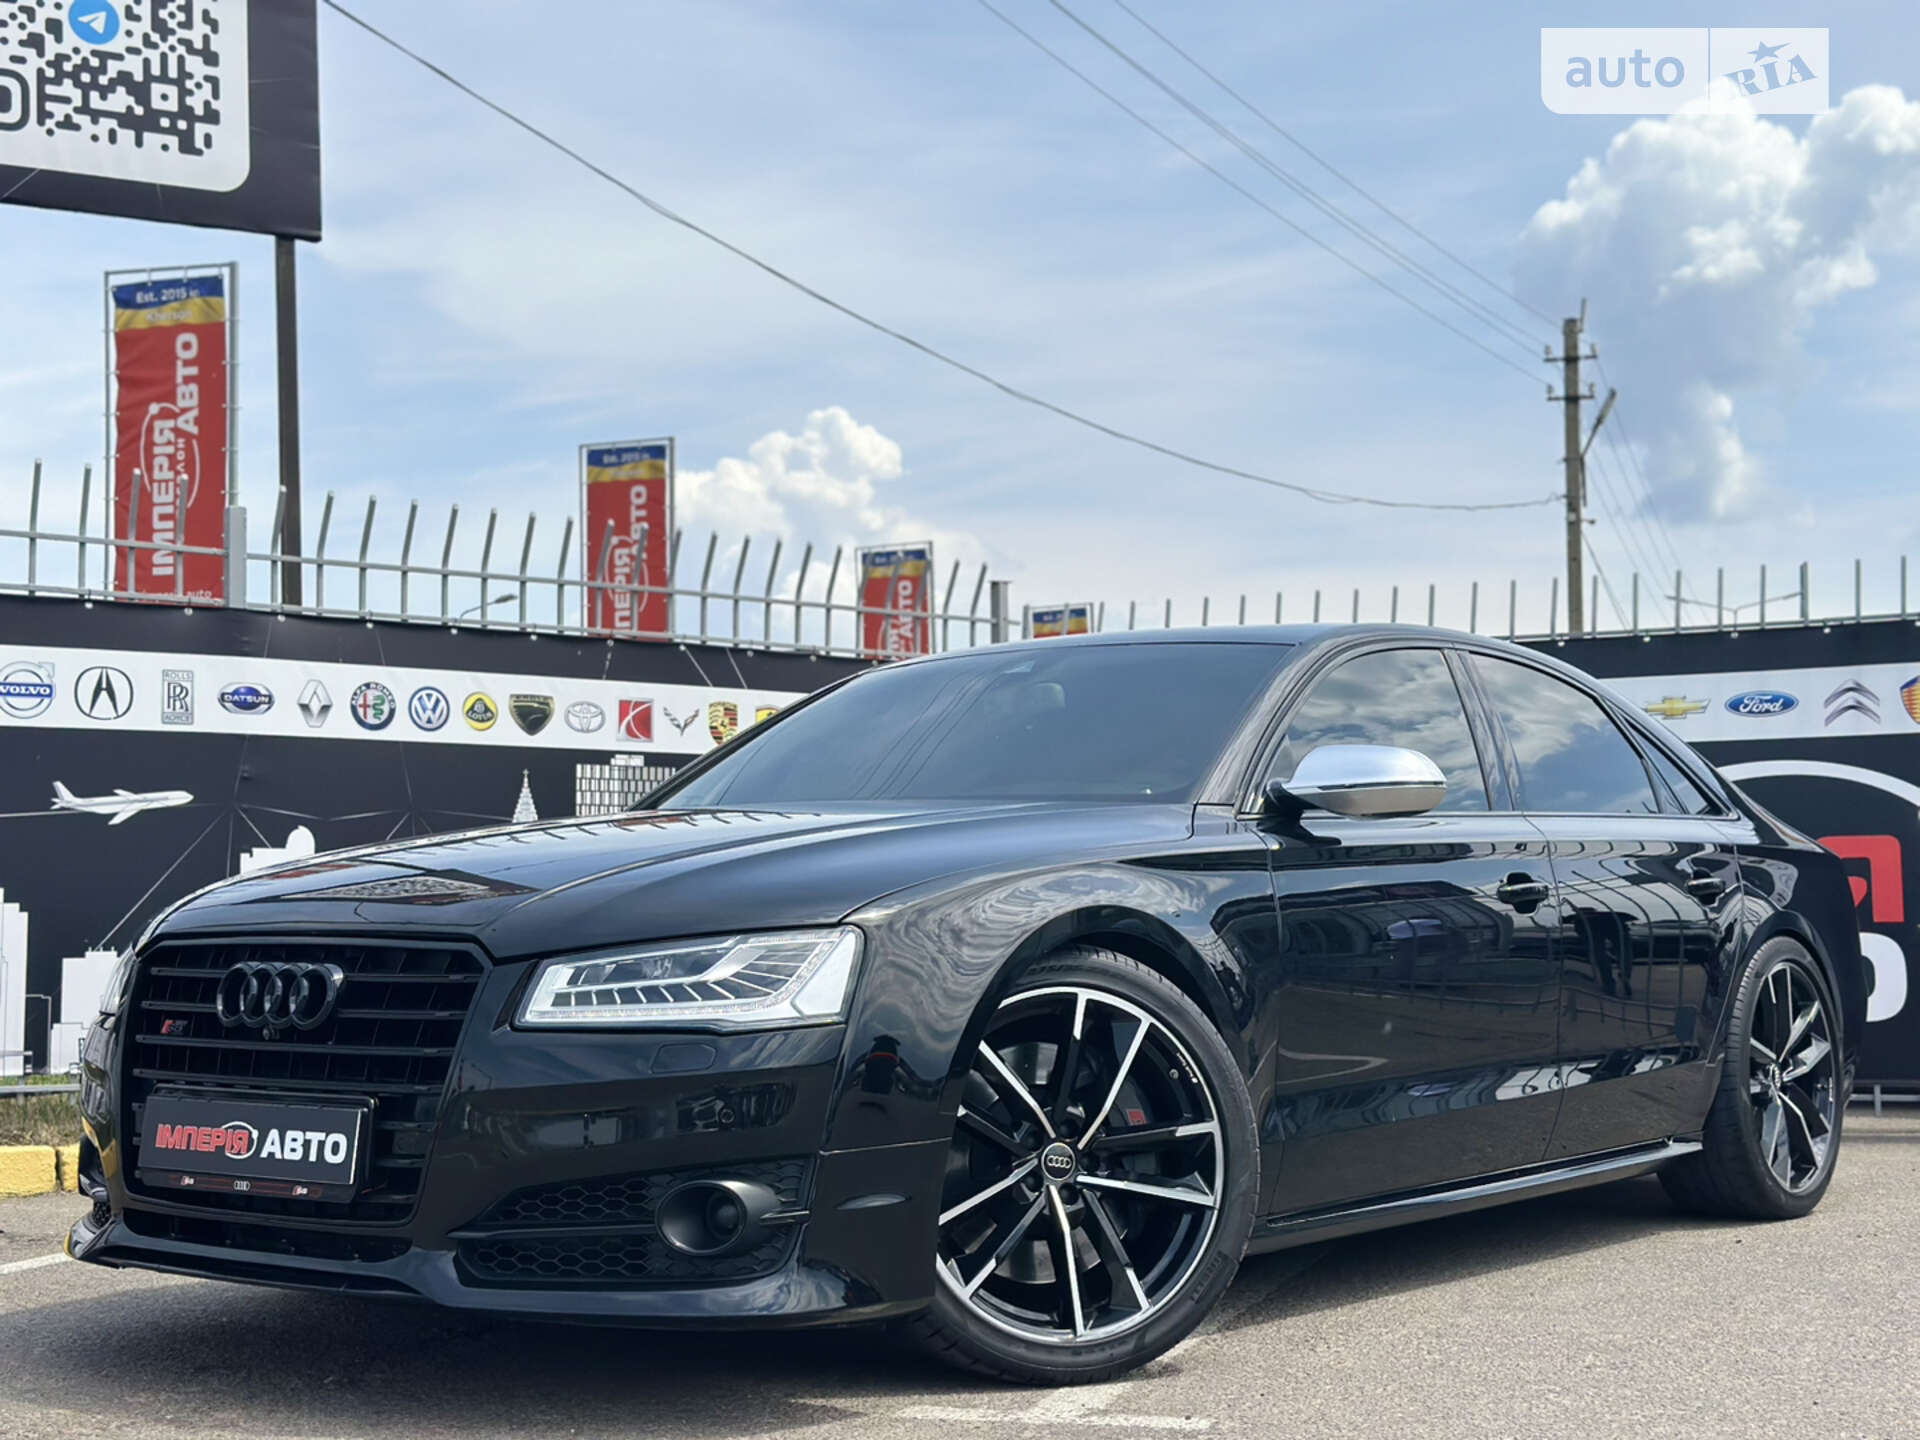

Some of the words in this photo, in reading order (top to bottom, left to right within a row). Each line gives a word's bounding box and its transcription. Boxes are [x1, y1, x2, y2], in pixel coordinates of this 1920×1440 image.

[161, 287, 187, 301] 2015
[175, 332, 199, 435] АВТО
[152, 418, 176, 577] ІМПЕРІЯ
[0, 684, 51, 695] VOLVO
[223, 694, 270, 704] DATSUN
[1739, 695, 1785, 713] Ford
[155, 1123, 249, 1155] ІМПЕРІЯ
[259, 1128, 348, 1165] АВТО
